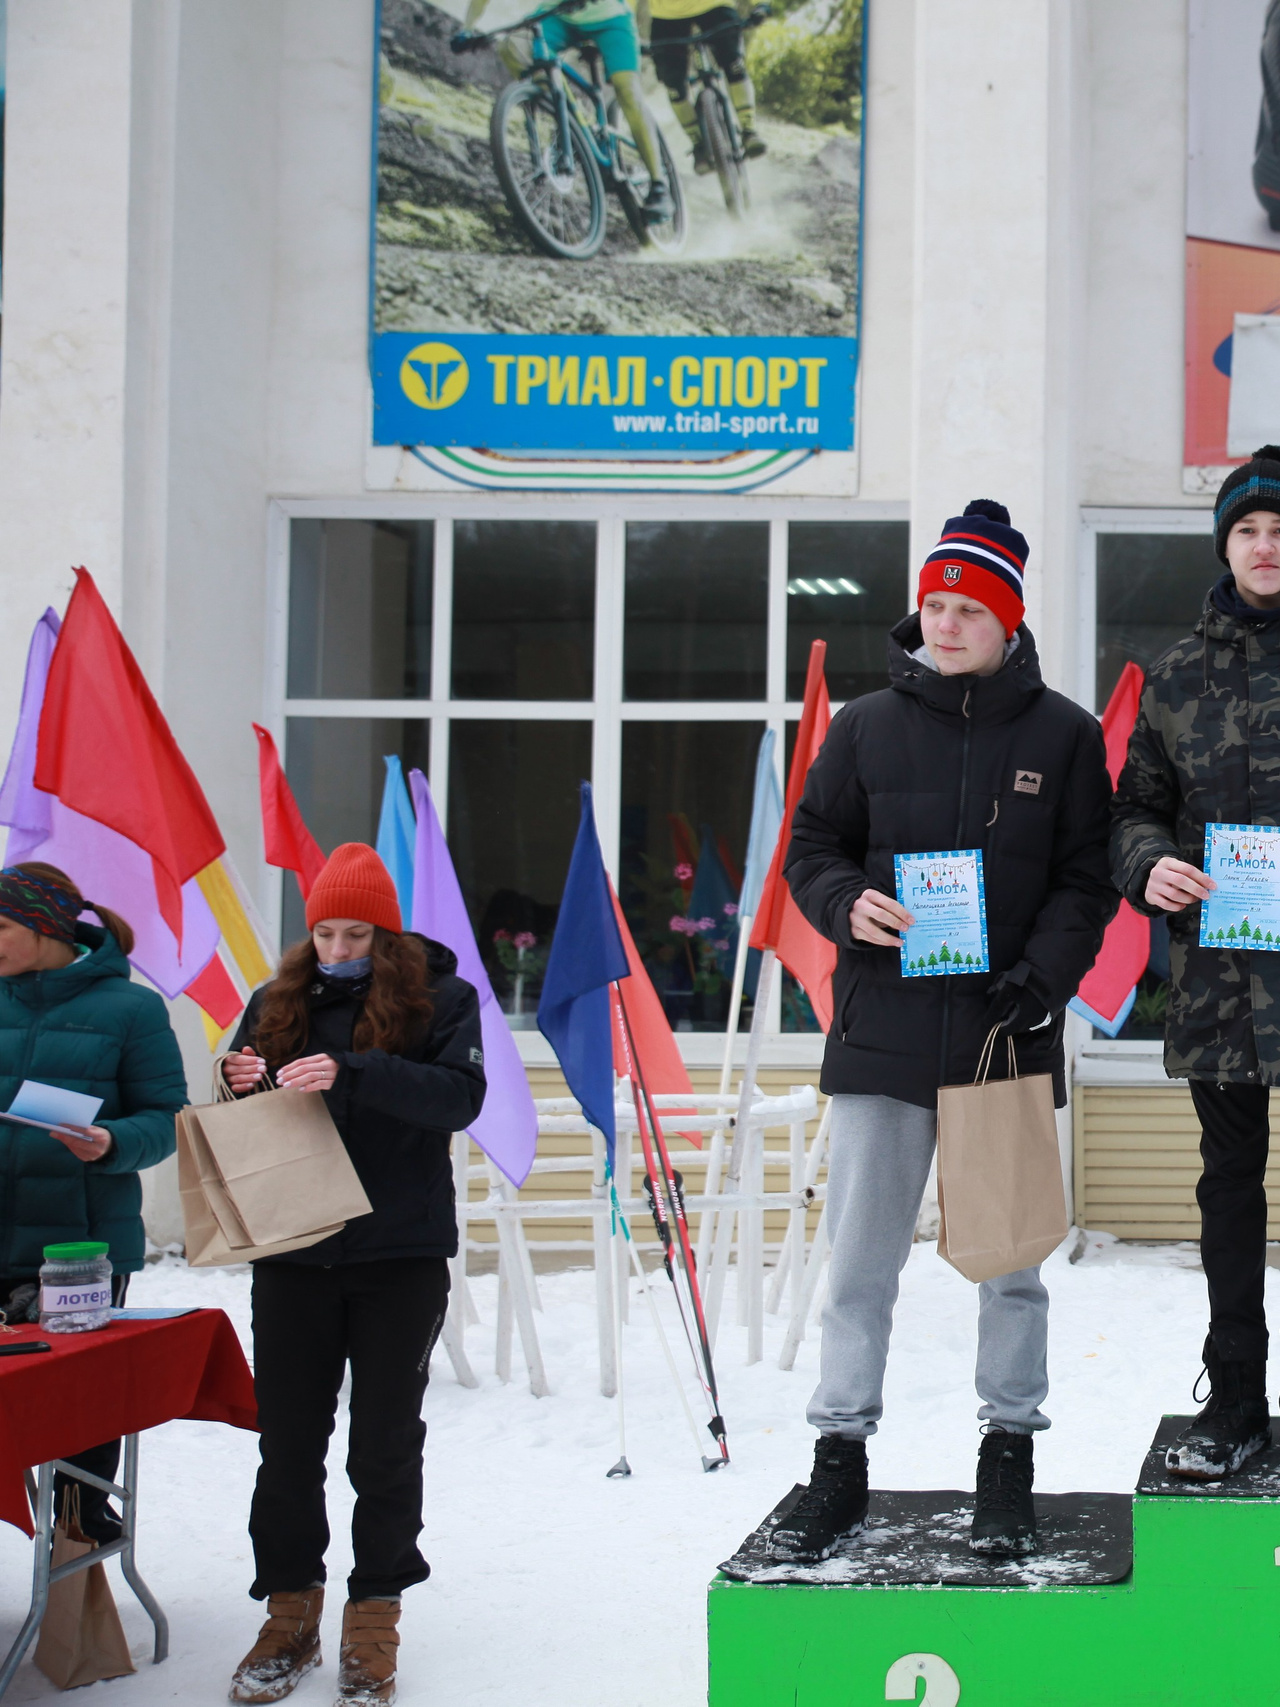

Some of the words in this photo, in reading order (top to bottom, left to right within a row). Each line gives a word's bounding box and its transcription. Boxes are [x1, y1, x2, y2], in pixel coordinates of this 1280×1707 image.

[612, 411, 820, 438] www.trial-sport.ru
[1219, 857, 1277, 870] ГРАМОТА
[911, 884, 968, 896] ГРАМОТА
[652, 1180, 668, 1222] NORDWAY
[667, 1178, 685, 1220] NORDWAY
